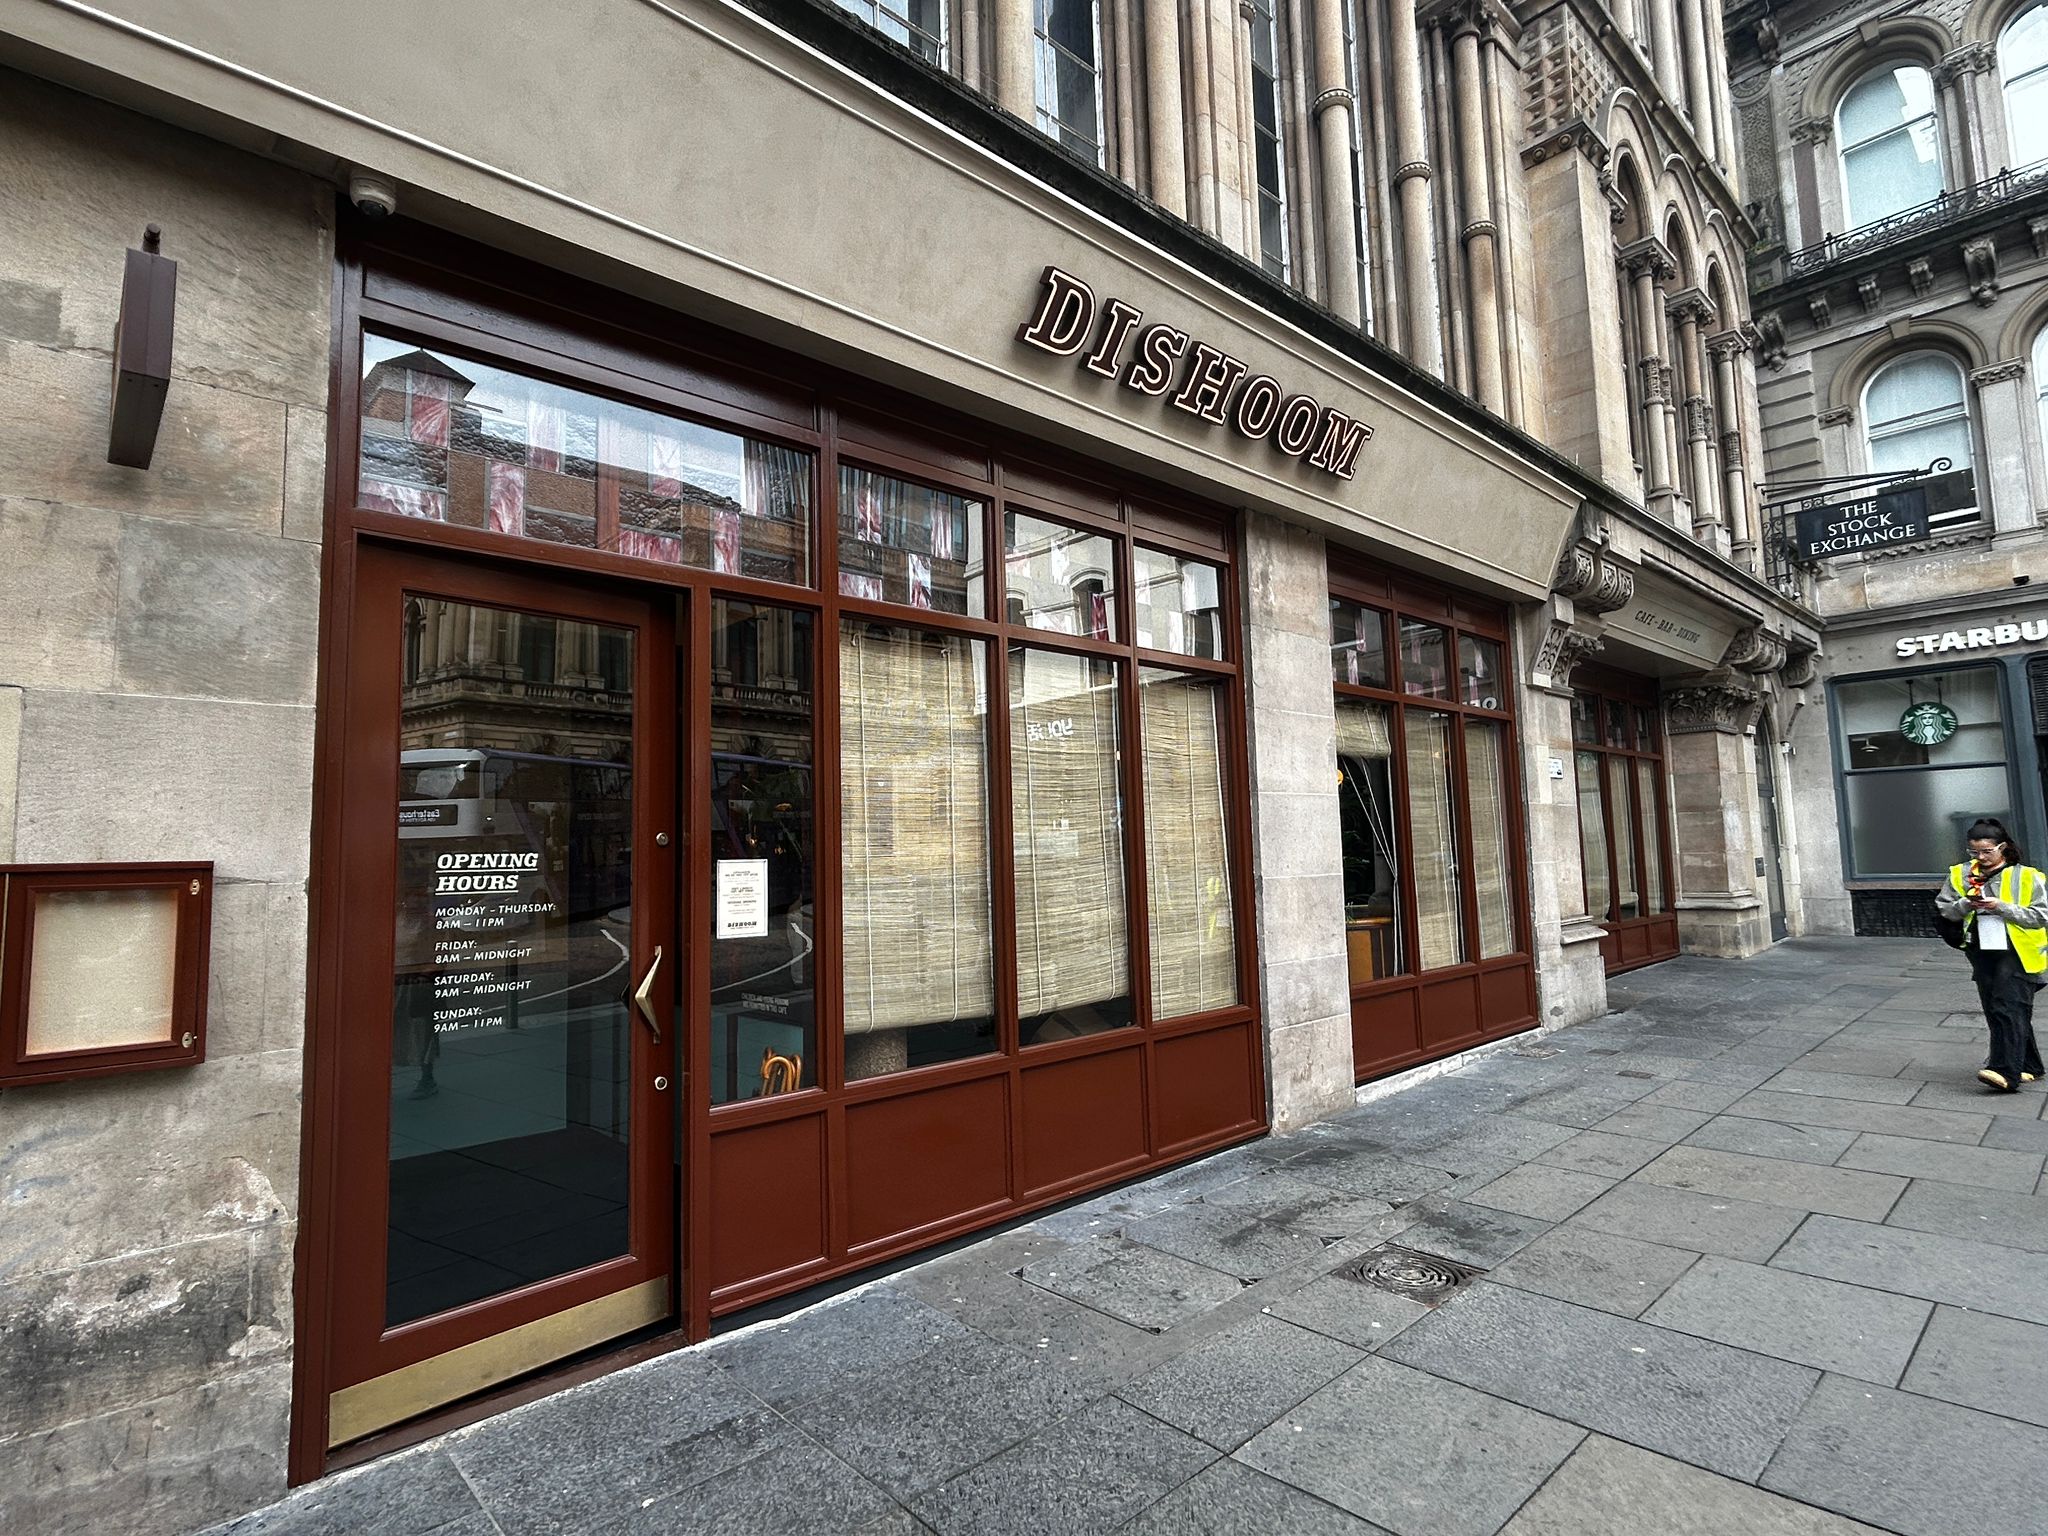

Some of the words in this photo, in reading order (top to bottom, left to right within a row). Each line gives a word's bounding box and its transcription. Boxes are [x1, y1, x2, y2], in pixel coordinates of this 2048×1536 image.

[1015, 266, 1374, 480] DISHOOM
[1840, 501, 1877, 518] THE
[1828, 513, 1893, 536] STOCK
[1810, 524, 1916, 554] EXCHANGE
[1657, 619, 1674, 633] BAR
[1896, 619, 2048, 657] STARBU
[437, 853, 539, 869] OPENING
[435, 875, 519, 892] HOURS
[435, 906, 486, 918] MONDAY
[499, 903, 557, 913] THURSDAY:
[436, 920, 460, 930] 8AM
[476, 918, 504, 928] 11PM
[435, 940, 478, 951] FRIDAY:
[435, 954, 460, 964] 8AM
[474, 948, 532, 961] MIDNIGHT
[434, 972, 495, 986] SATURDAY:
[435, 988, 459, 999] 9AM
[473, 980, 532, 995] MIDNIGHT
[433, 1007, 483, 1021] SUNDAY:
[434, 1022, 458, 1033] 9AM
[474, 1017, 502, 1028] 11PM
